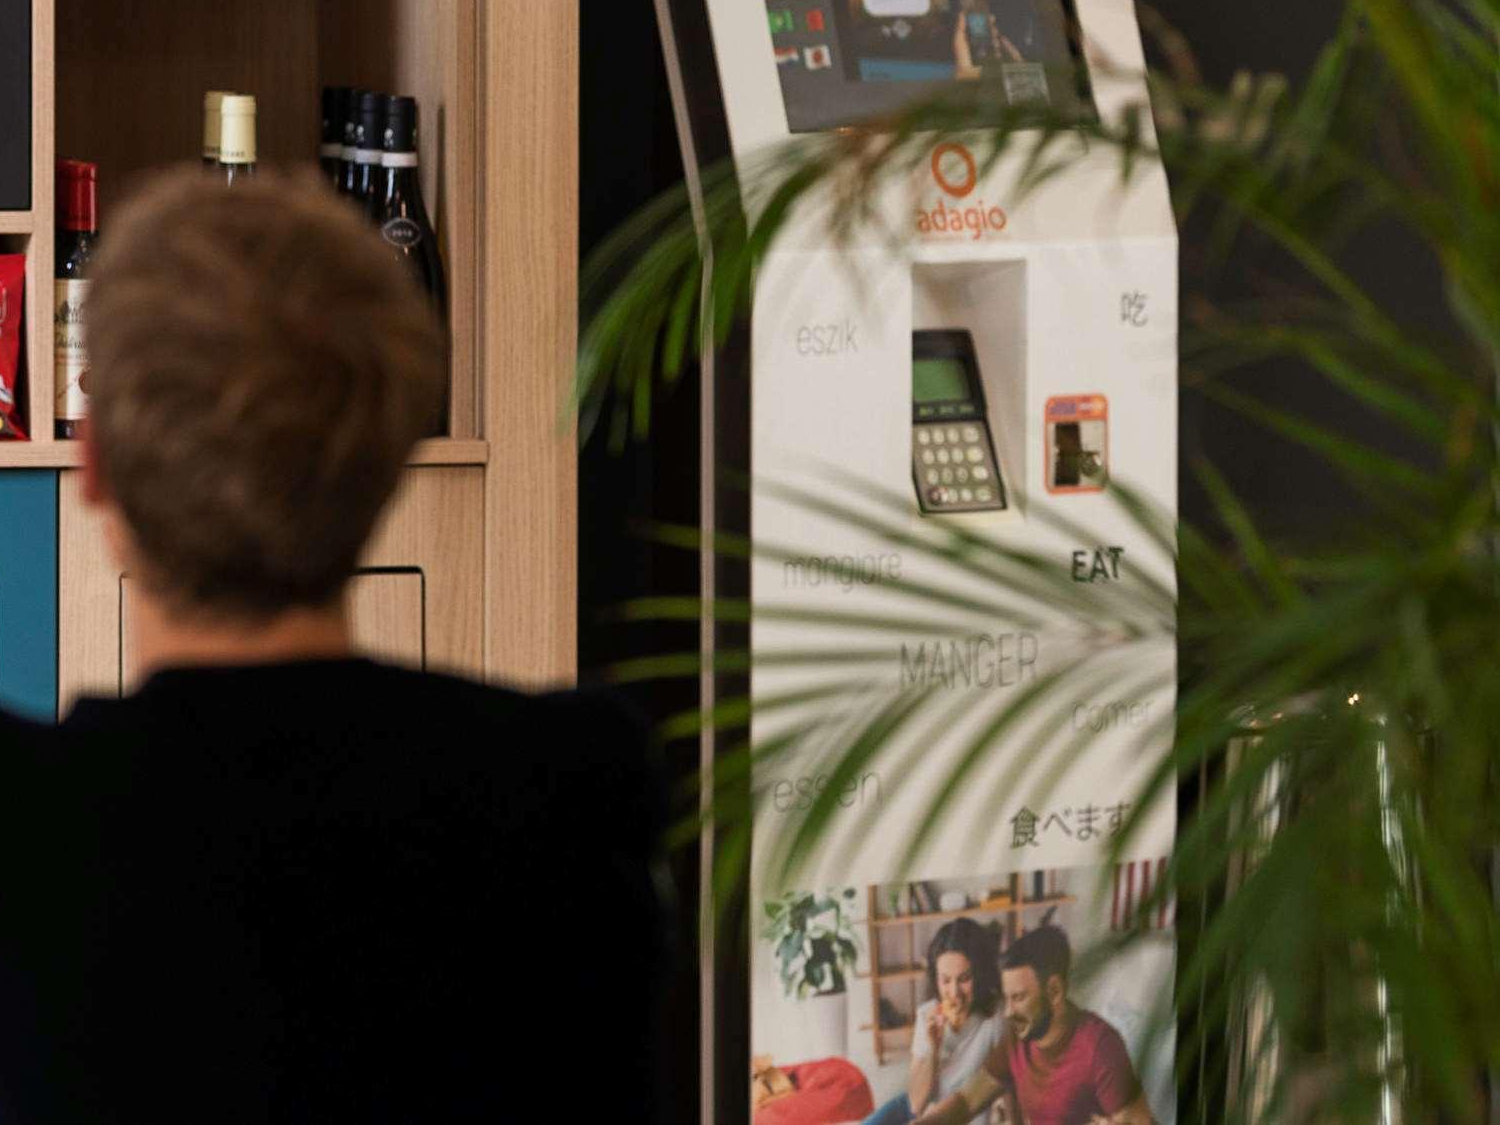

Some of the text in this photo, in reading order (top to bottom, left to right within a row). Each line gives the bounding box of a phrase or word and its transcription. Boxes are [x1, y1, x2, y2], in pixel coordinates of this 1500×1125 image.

[916, 200, 1008, 240] adagio
[796, 322, 859, 356] eszik
[1071, 546, 1126, 583] EAT
[901, 631, 1040, 690] MANGER
